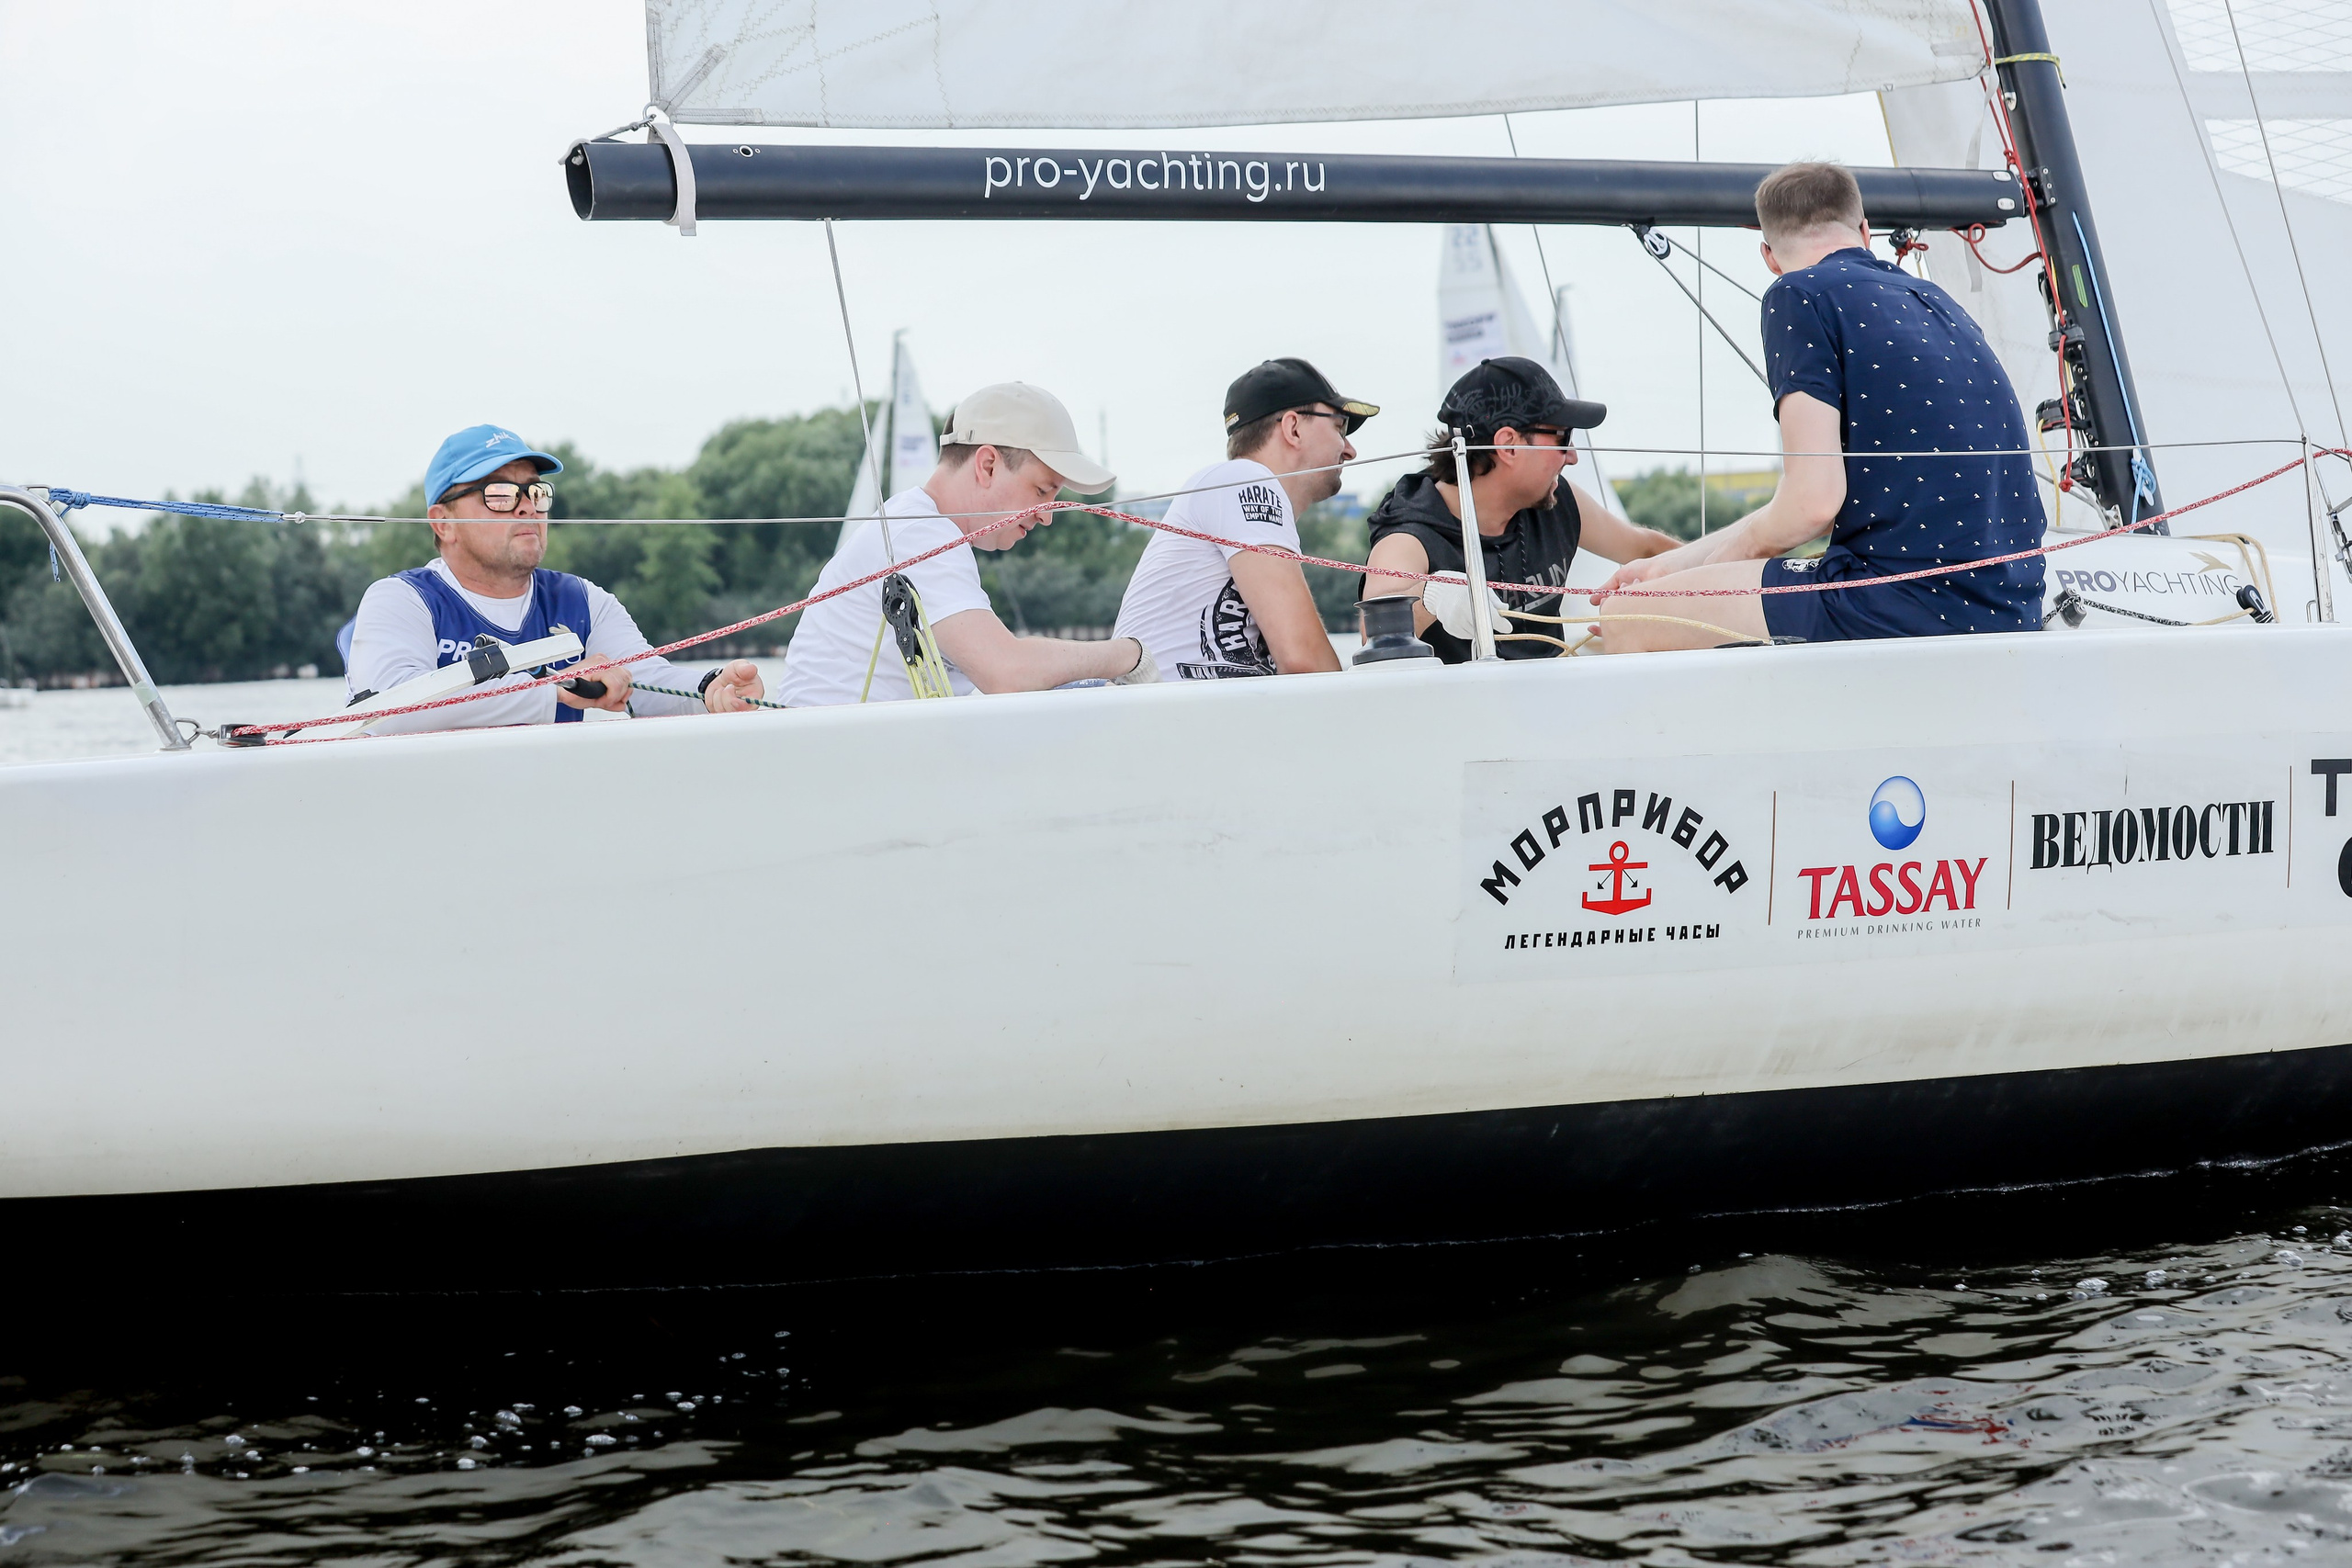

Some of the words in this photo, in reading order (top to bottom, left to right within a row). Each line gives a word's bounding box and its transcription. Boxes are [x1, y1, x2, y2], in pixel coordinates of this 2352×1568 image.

[984, 151, 1326, 203] pro-yachting.ru
[1238, 485, 1283, 509] KARATE
[1242, 504, 1259, 513] WAY
[1260, 505, 1270, 513] OF
[1245, 513, 1267, 521] EMPTY
[1480, 789, 1749, 906] МОРПРИБОР
[2030, 800, 2275, 874] ВЕДОМОСТИ
[1797, 857, 1989, 919] TASSAY
[1504, 927, 1656, 950] ЛЕГЕНДАРНЫЕ
[1666, 923, 1720, 941] ЧАСЫ
[1797, 926, 1860, 940] PREMIUM
[1867, 920, 1934, 935] DRINKING
[1940, 918, 1982, 930] WATER
